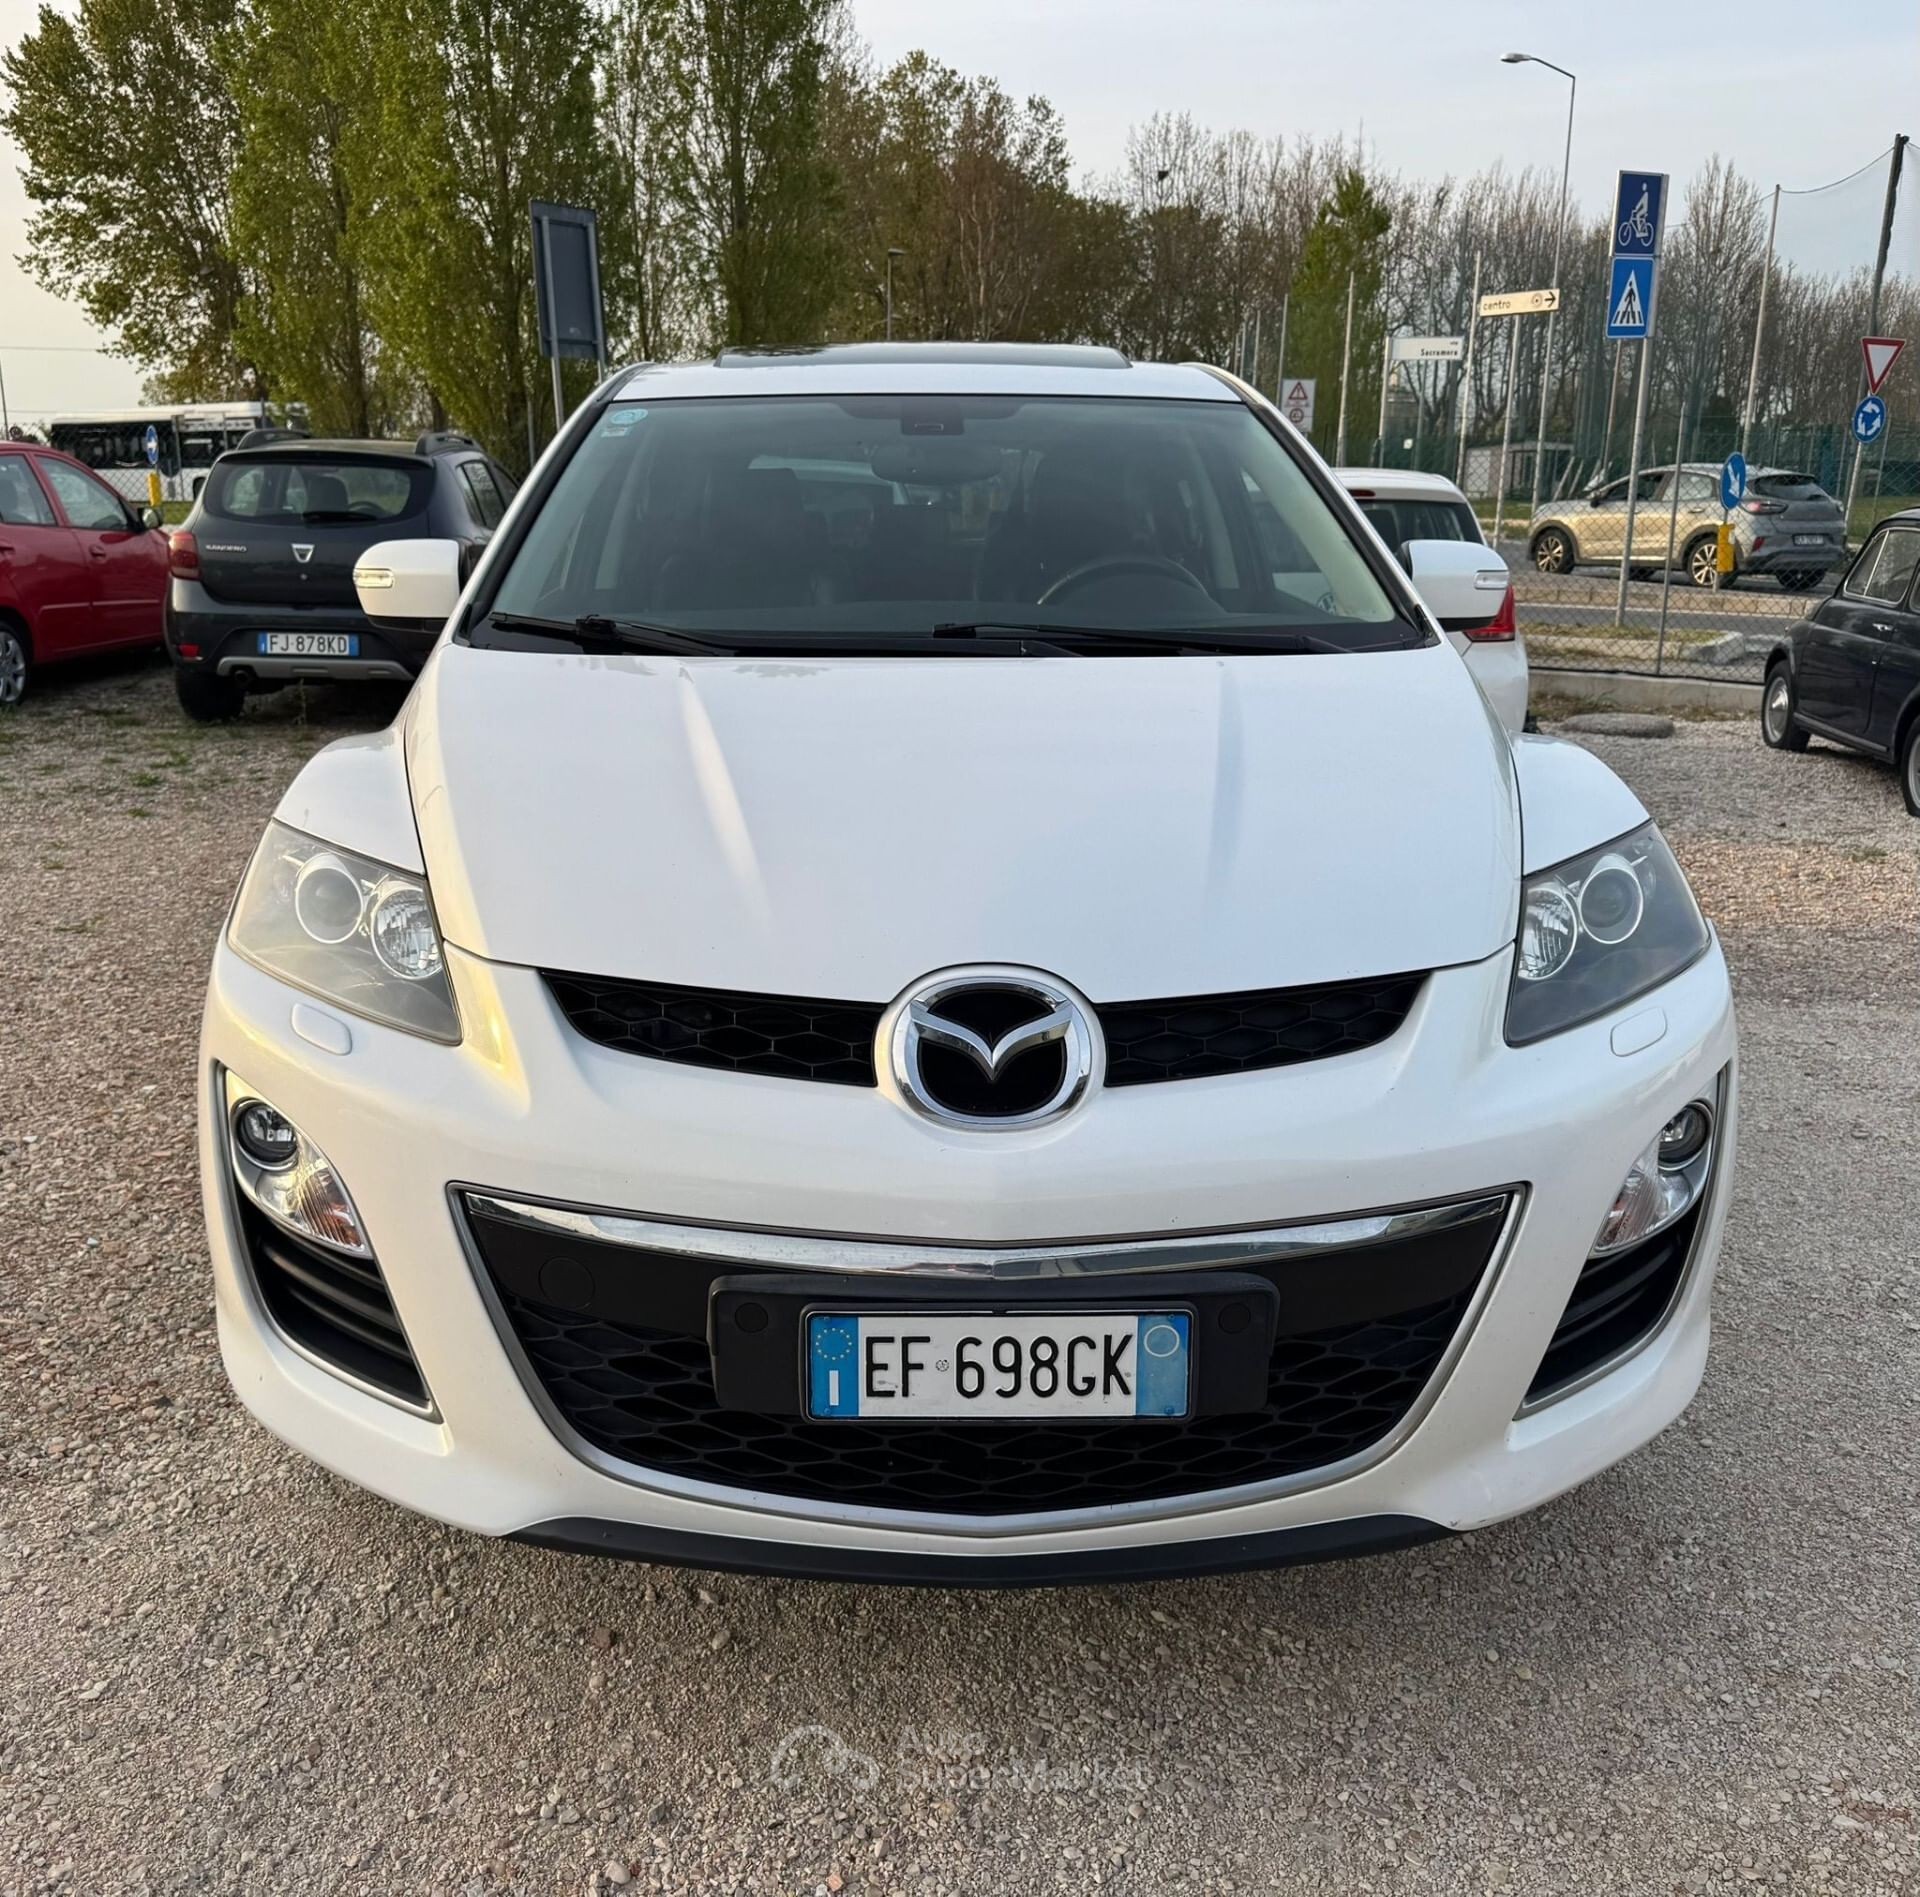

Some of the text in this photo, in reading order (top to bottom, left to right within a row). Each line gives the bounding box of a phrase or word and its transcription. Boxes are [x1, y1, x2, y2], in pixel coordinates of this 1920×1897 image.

[269, 634, 348, 654] FJ 878KD
[865, 1333, 1134, 1400] EF 698GK
